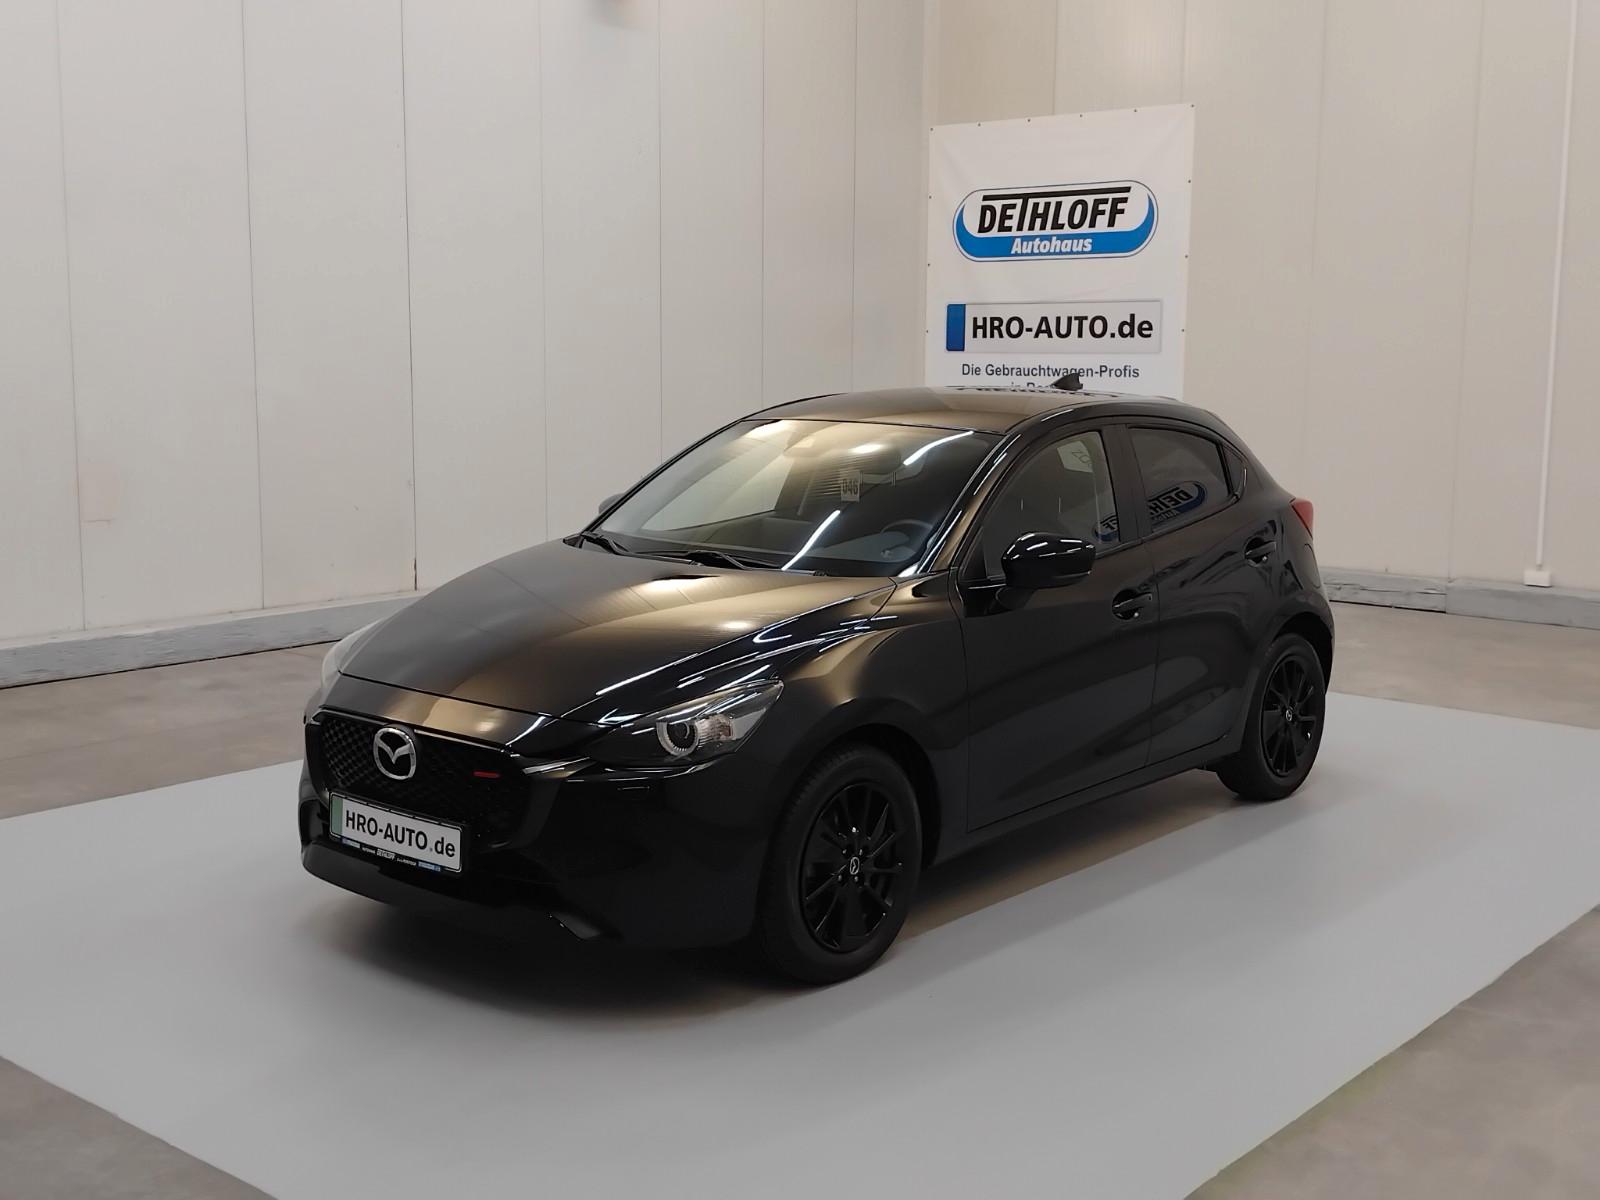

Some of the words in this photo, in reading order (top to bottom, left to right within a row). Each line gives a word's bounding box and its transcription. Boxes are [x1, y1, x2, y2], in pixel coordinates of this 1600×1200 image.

[977, 186, 1131, 234] DETHLOFF
[1010, 236, 1092, 255] Autohaus
[972, 313, 1153, 339] HRO-AUTO.de
[961, 363, 981, 376] Die
[345, 810, 456, 858] HRO-AUTO.de
